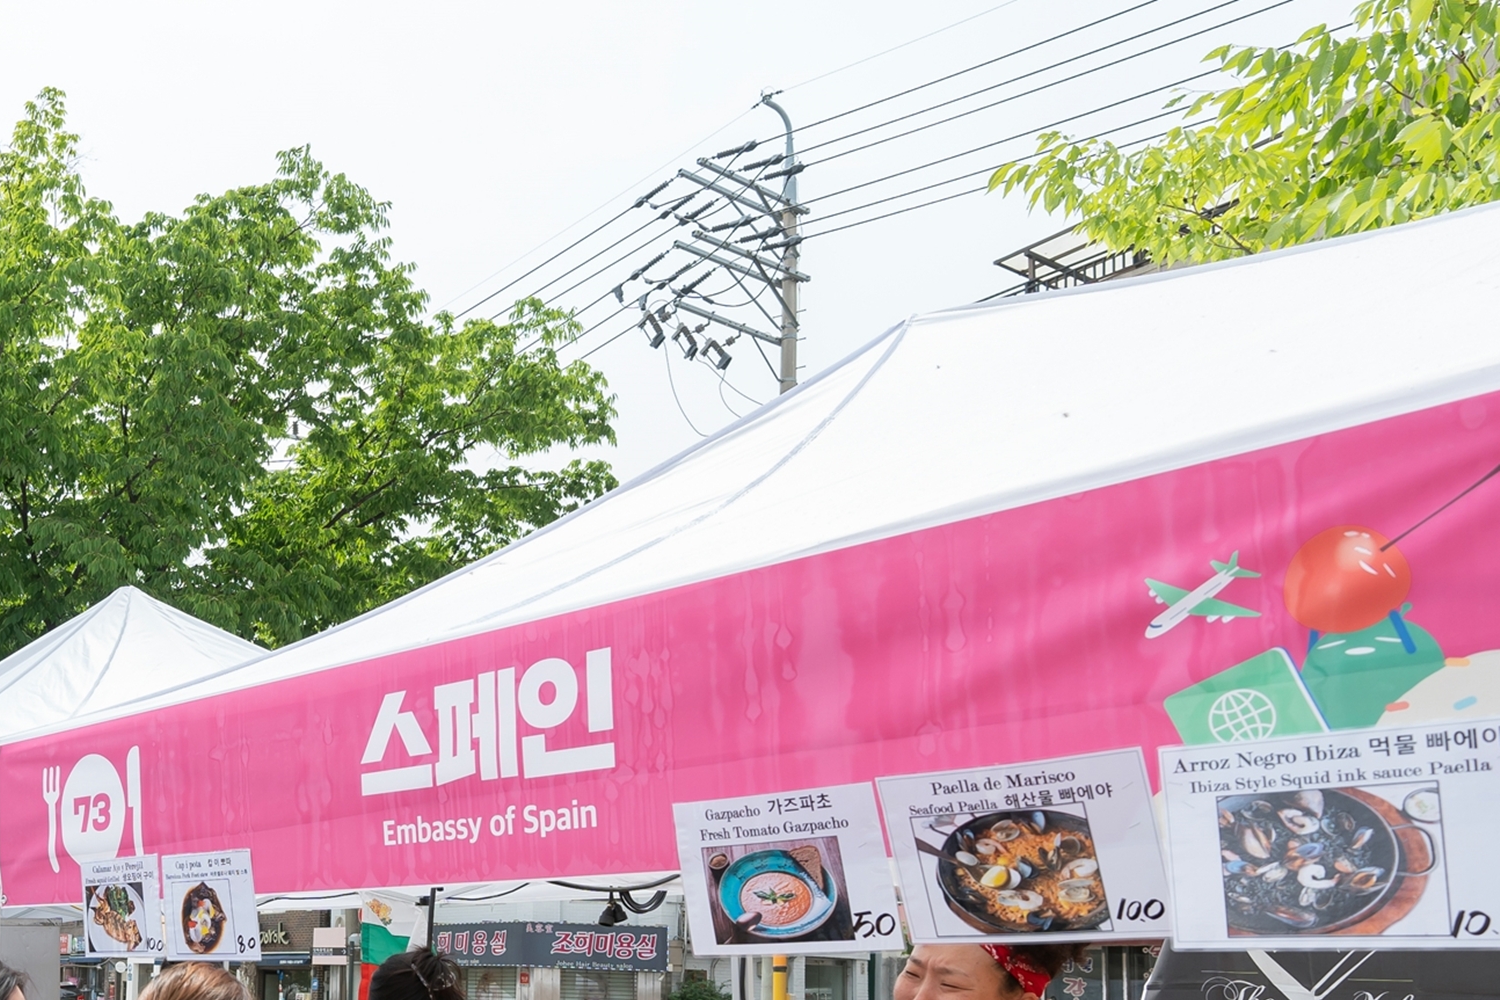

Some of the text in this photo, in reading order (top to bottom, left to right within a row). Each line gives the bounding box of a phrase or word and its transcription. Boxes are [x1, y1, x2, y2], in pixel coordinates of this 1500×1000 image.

[360, 647, 616, 797] 스페인
[1173, 757, 1230, 774] Arroz
[1236, 750, 1297, 772] Negro
[1302, 743, 1361, 762] Ibiza
[1369, 734, 1417, 757] 먹물
[930, 770, 1076, 796] Paella de Marisco
[1189, 758, 1493, 794] Ibiza Style Squid ink sauce Paella
[73, 793, 112, 833] 73
[705, 793, 832, 823] Gazpacho 가즈파초
[909, 782, 1113, 816] Seafood Paella 해산물 빠에야
[383, 798, 597, 847] Embassy of Spain
[700, 816, 849, 842] Fresh Tomato Gazpacho
[551, 931, 657, 960] 조희미용실
